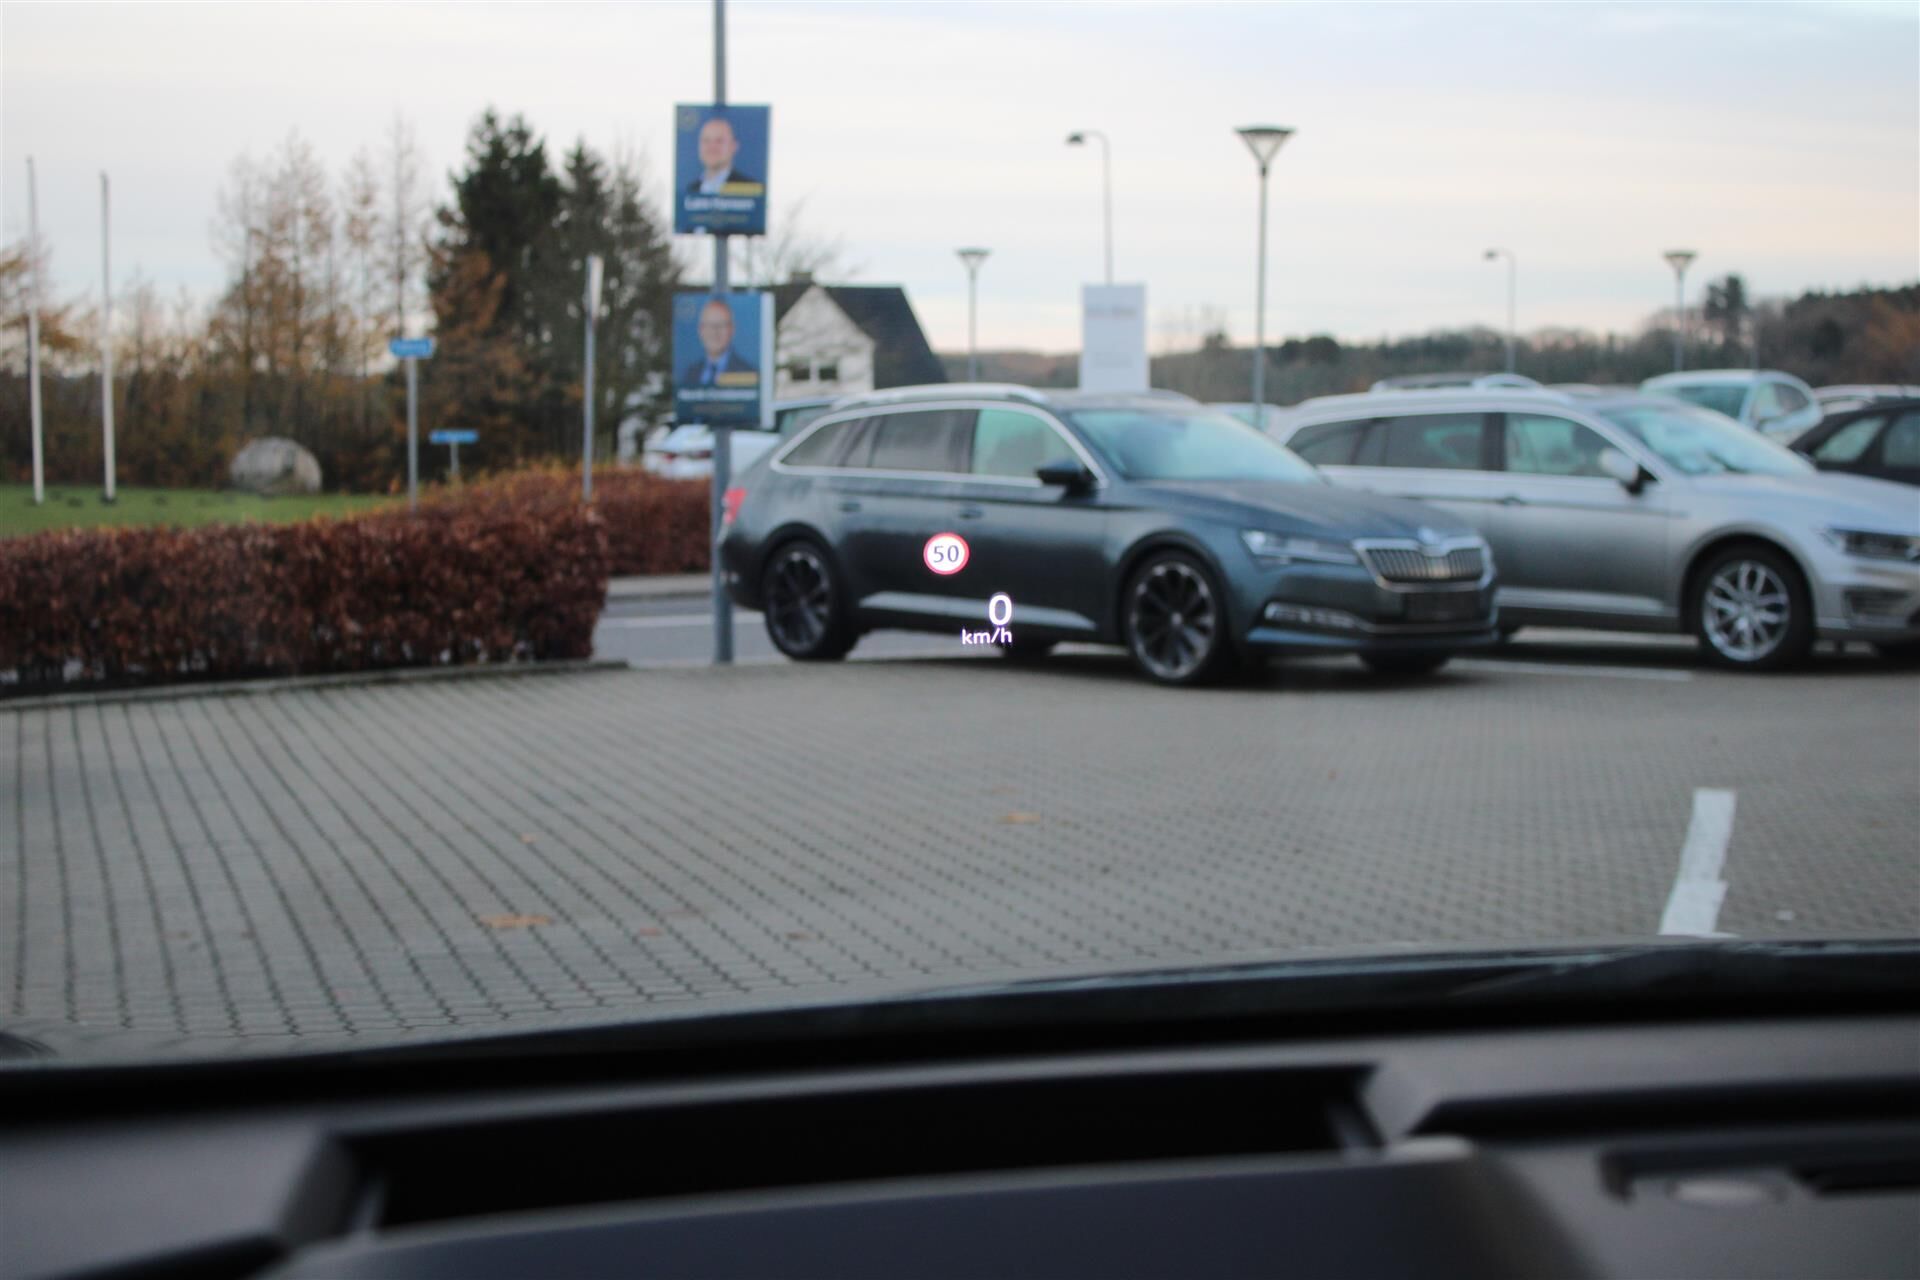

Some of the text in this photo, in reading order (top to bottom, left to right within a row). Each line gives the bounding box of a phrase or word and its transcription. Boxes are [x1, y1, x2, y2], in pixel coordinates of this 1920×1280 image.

[933, 545, 960, 563] 50
[988, 593, 1012, 626] 0
[961, 627, 1012, 645] km/h
